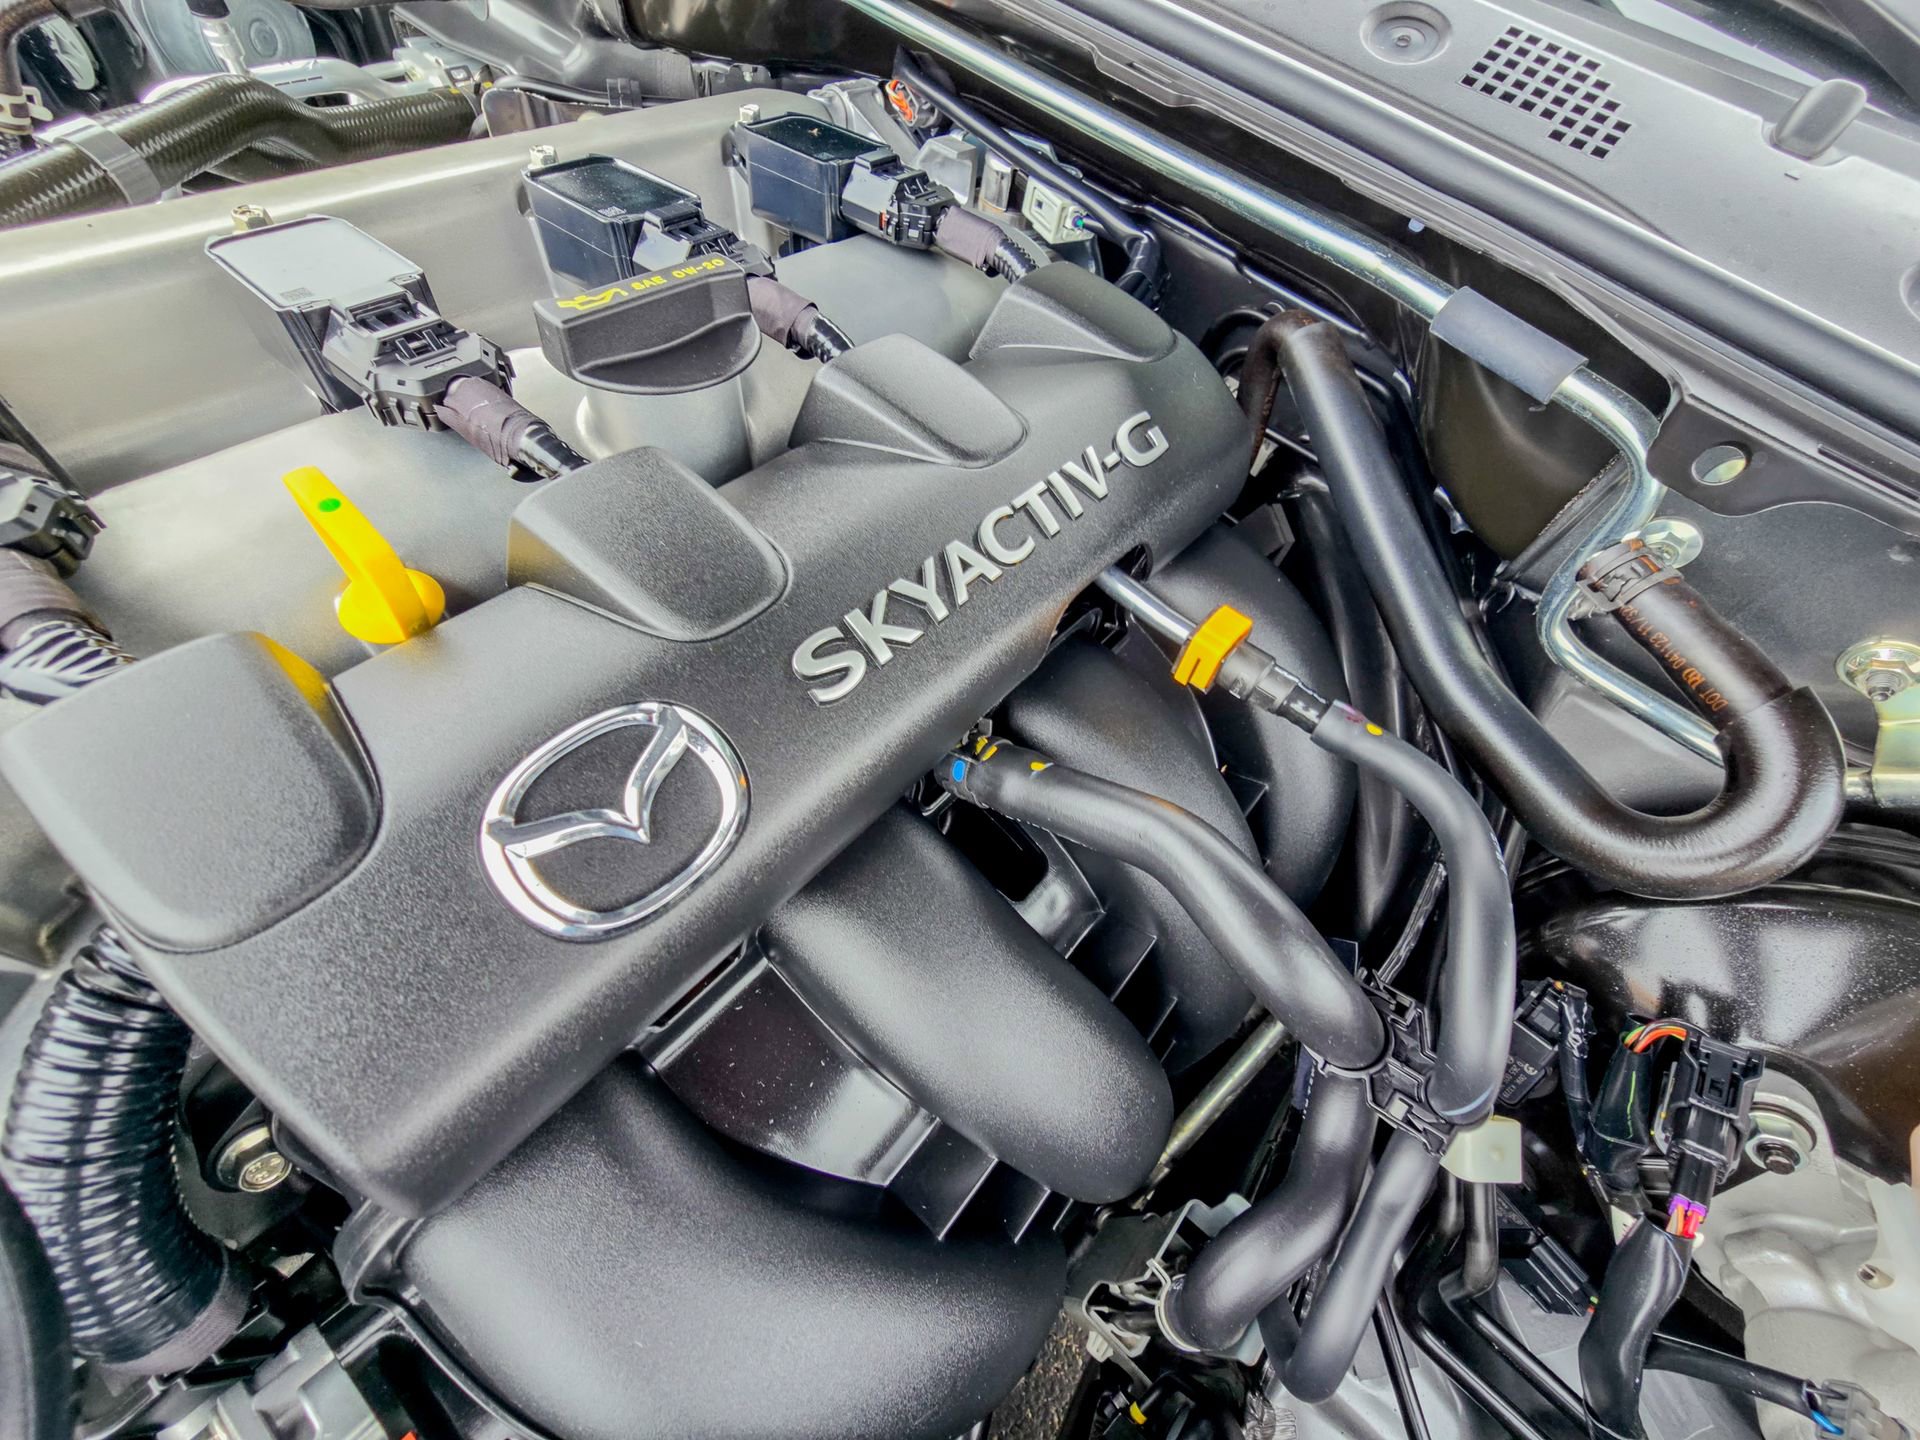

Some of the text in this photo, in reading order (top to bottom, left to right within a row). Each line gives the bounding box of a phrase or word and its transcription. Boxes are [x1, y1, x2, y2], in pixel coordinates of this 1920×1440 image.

[631, 258, 725, 291] SAE 0W-20
[791, 410, 1170, 707] SKYACTIV-G
[1699, 687, 1729, 712] DOT
